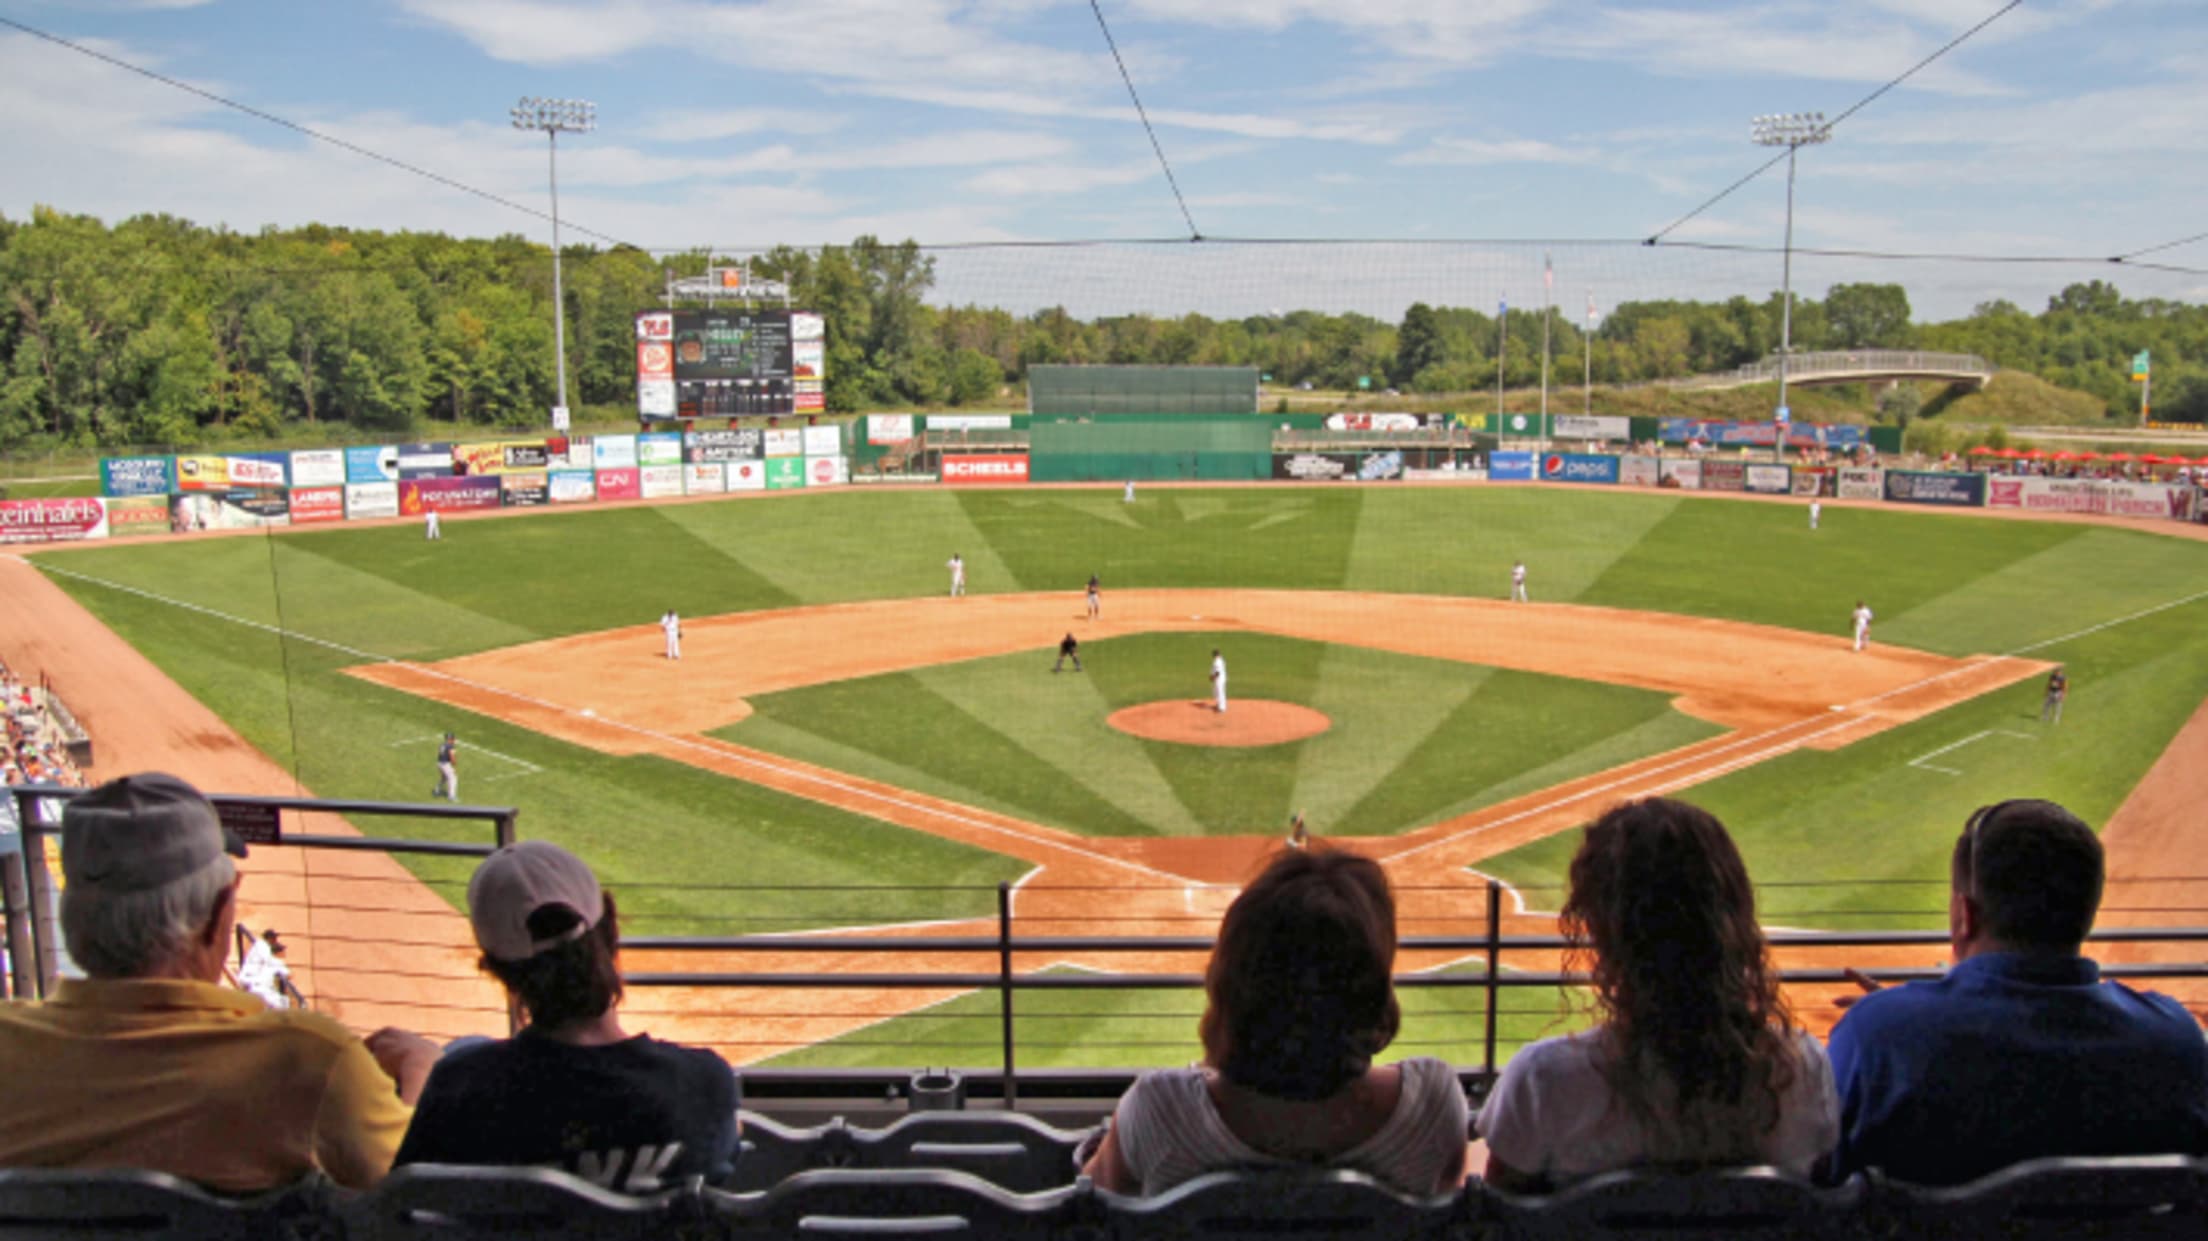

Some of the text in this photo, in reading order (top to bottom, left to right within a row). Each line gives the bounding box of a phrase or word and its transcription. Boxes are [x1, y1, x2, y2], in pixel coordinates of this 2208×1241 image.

[943, 461, 1027, 475] SCHEELS
[1567, 461, 1608, 477] pepsi
[0, 502, 101, 526] einhafels
